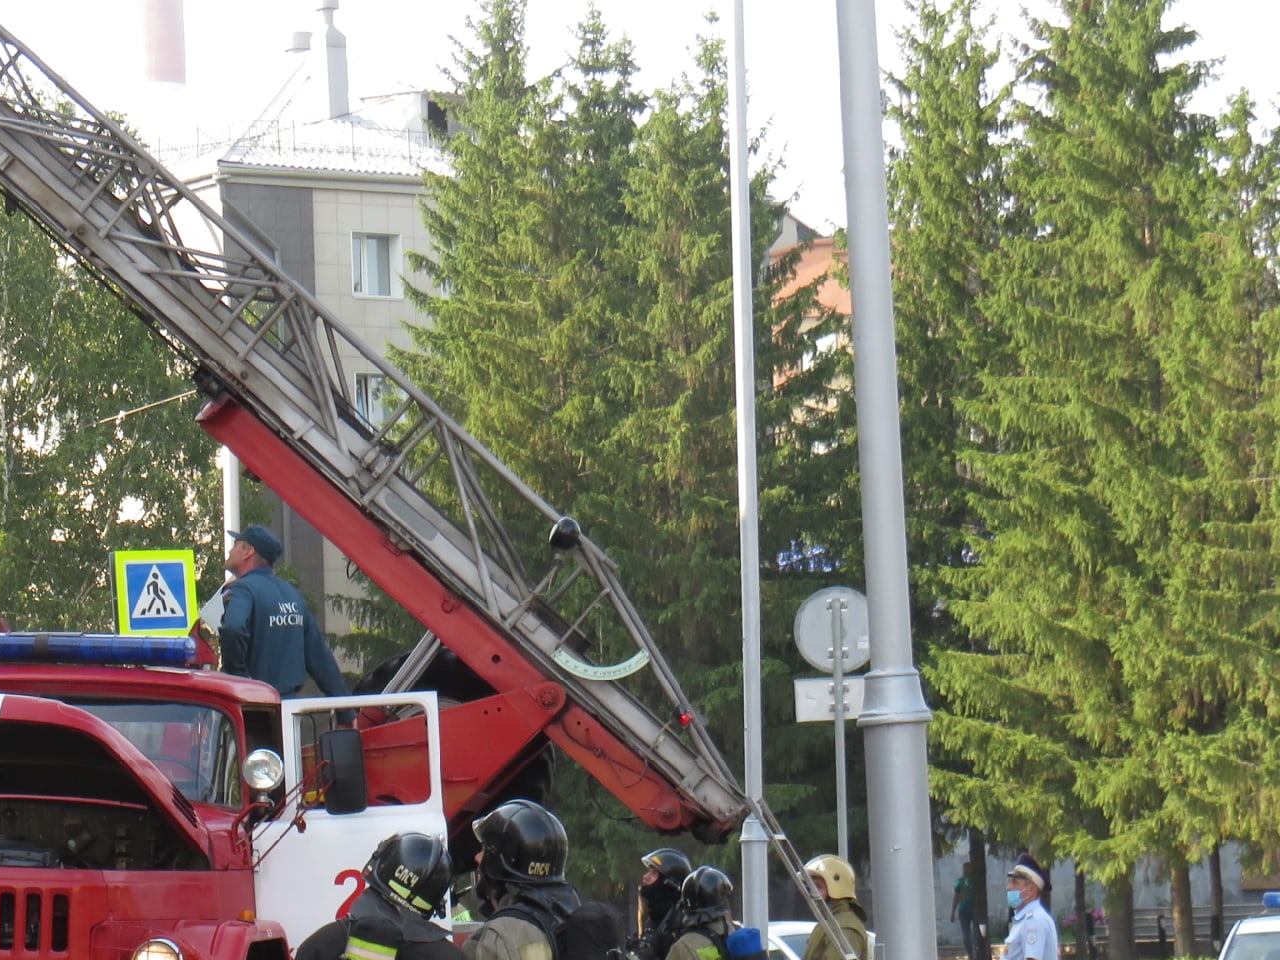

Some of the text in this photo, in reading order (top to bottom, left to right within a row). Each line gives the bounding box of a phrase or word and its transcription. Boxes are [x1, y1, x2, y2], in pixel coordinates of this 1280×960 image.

[278, 601, 298, 614] МЧС
[269, 613, 304, 628] РОССИИ
[394, 864, 420, 888] СПСЧ
[527, 861, 552, 876] СПСЧ
